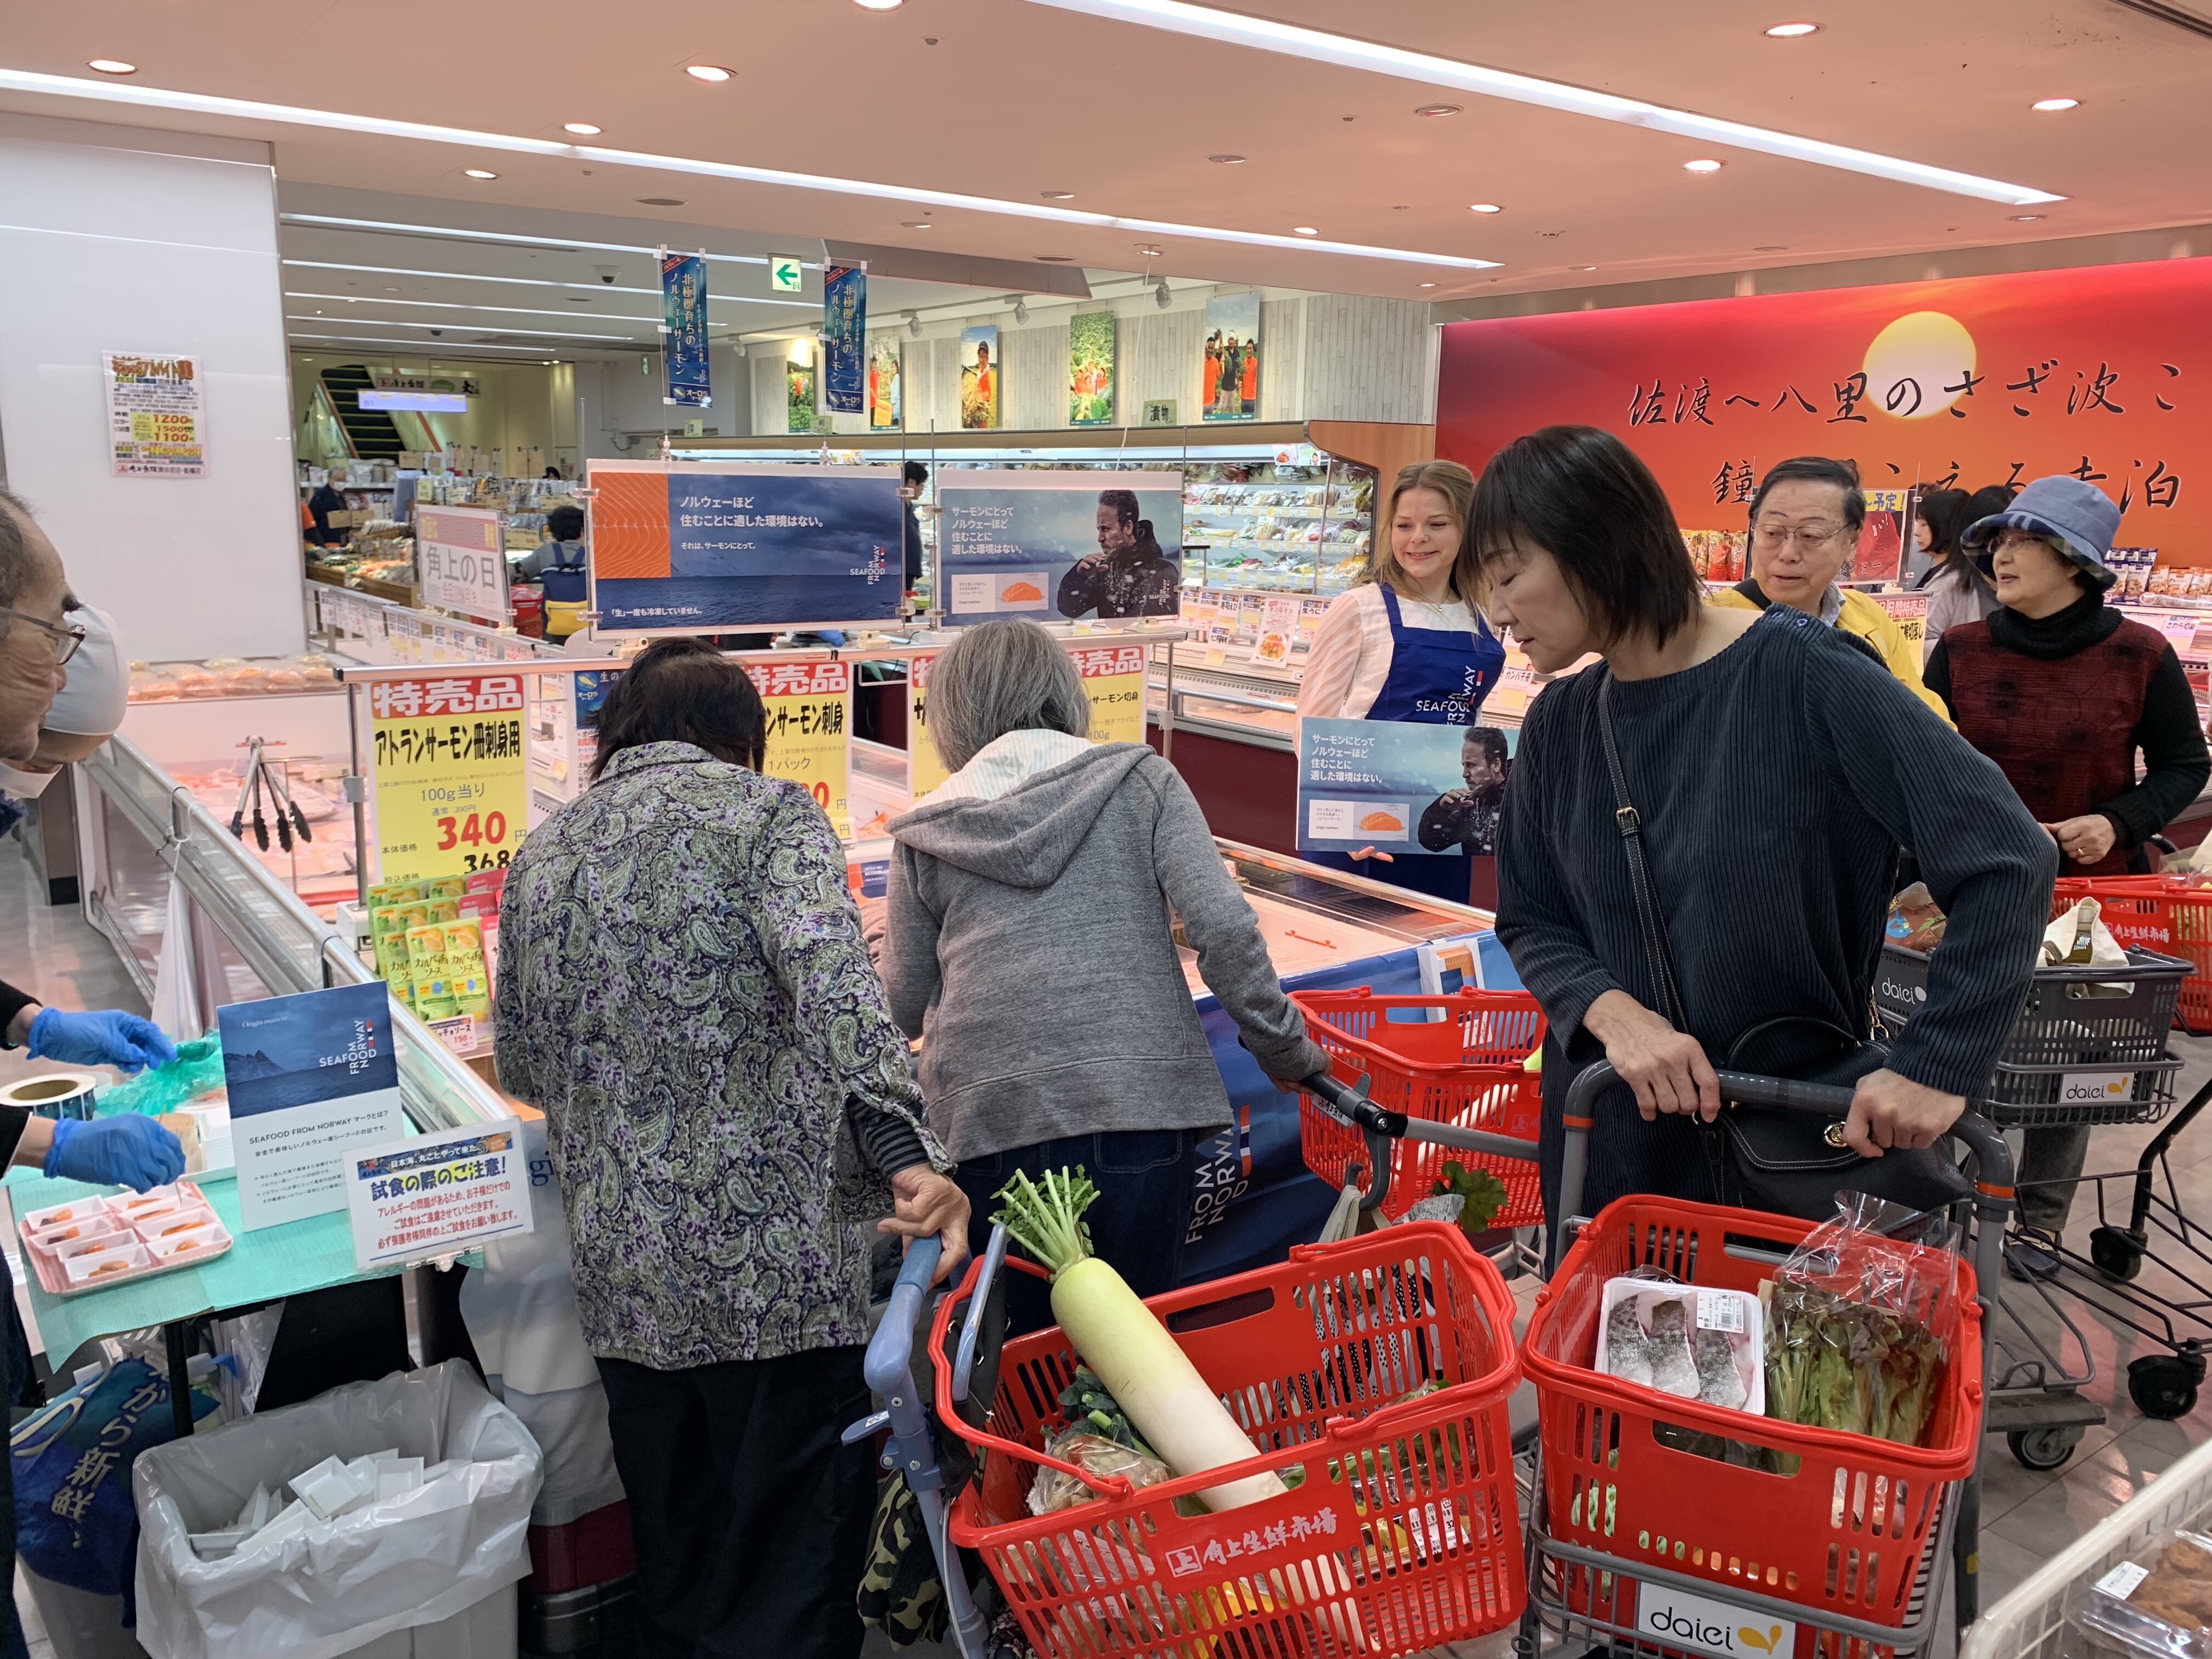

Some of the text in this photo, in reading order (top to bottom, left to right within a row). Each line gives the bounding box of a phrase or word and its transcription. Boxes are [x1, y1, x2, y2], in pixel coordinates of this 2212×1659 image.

[682, 273, 696, 345] 北極圏育ちの
[843, 284, 855, 353] 北極圏育ちの
[670, 273, 686, 375] ノルウェーサーモン
[831, 284, 843, 382] ノルウェーサーモン
[1150, 405, 1169, 421] 漬物
[680, 496, 754, 509] ノルウェーほど
[951, 506, 1014, 517] サーモンにとって
[680, 515, 823, 527] 住むことに適した環境はない。
[951, 518, 1008, 529] ノルウェーほど
[681, 541, 757, 550] それは、サーモンにとって。
[951, 532, 992, 542] 住むことに
[951, 543, 1023, 555] 適した環境はない。
[426, 544, 496, 590] 角上の日
[600, 670, 626, 683] 生の
[373, 676, 522, 718] 特売品
[1089, 691, 1139, 705] サーモン切身
[375, 720, 521, 767] アトランサーモン冊刺身用
[1312, 733, 1375, 747] サーモンにとって
[1312, 746, 1369, 759] ノルウェーほど
[1311, 759, 1352, 770] 住むことに
[1310, 770, 1383, 784] 適した環境はない。
[420, 782, 485, 802] 100g当り
[431, 804, 476, 816] 通常 390円
[837, 799, 847, 810] 円
[381, 811, 527, 854] 本体価格 340 円
[839, 824, 850, 836] 円
[463, 849, 510, 874] 368
[425, 966, 443, 975] ソース
[460, 963, 475, 975] ソース
[1881, 977, 1916, 1005] daiei
[241, 1019, 264, 1029] Origin
[354, 1020, 369, 1069] NORWAY
[319, 1049, 377, 1068] SEAFOOD
[347, 1041, 360, 1075] FROM
[2066, 1083, 2104, 1099] daiei
[249, 1110, 388, 1145] SEAFOOD FROM NORWAY マークとは?
[371, 1156, 506, 1202] 試食の際のご注意!
[377, 1180, 511, 1219] アレルギーの問題があるため、お子様だけでの
[1184, 1162, 1215, 1244] FROM
[394, 1199, 499, 1231] ご試食はご遠慮させていただきます。
[377, 1209, 518, 1250] 必ず保護者様同伴の上ご試食をお願い致します。
[51, 1369, 171, 1549] から新鮮!
[1203, 1506, 1338, 1566] 角上生鮮市場
[1650, 1606, 1734, 1651] daiei
